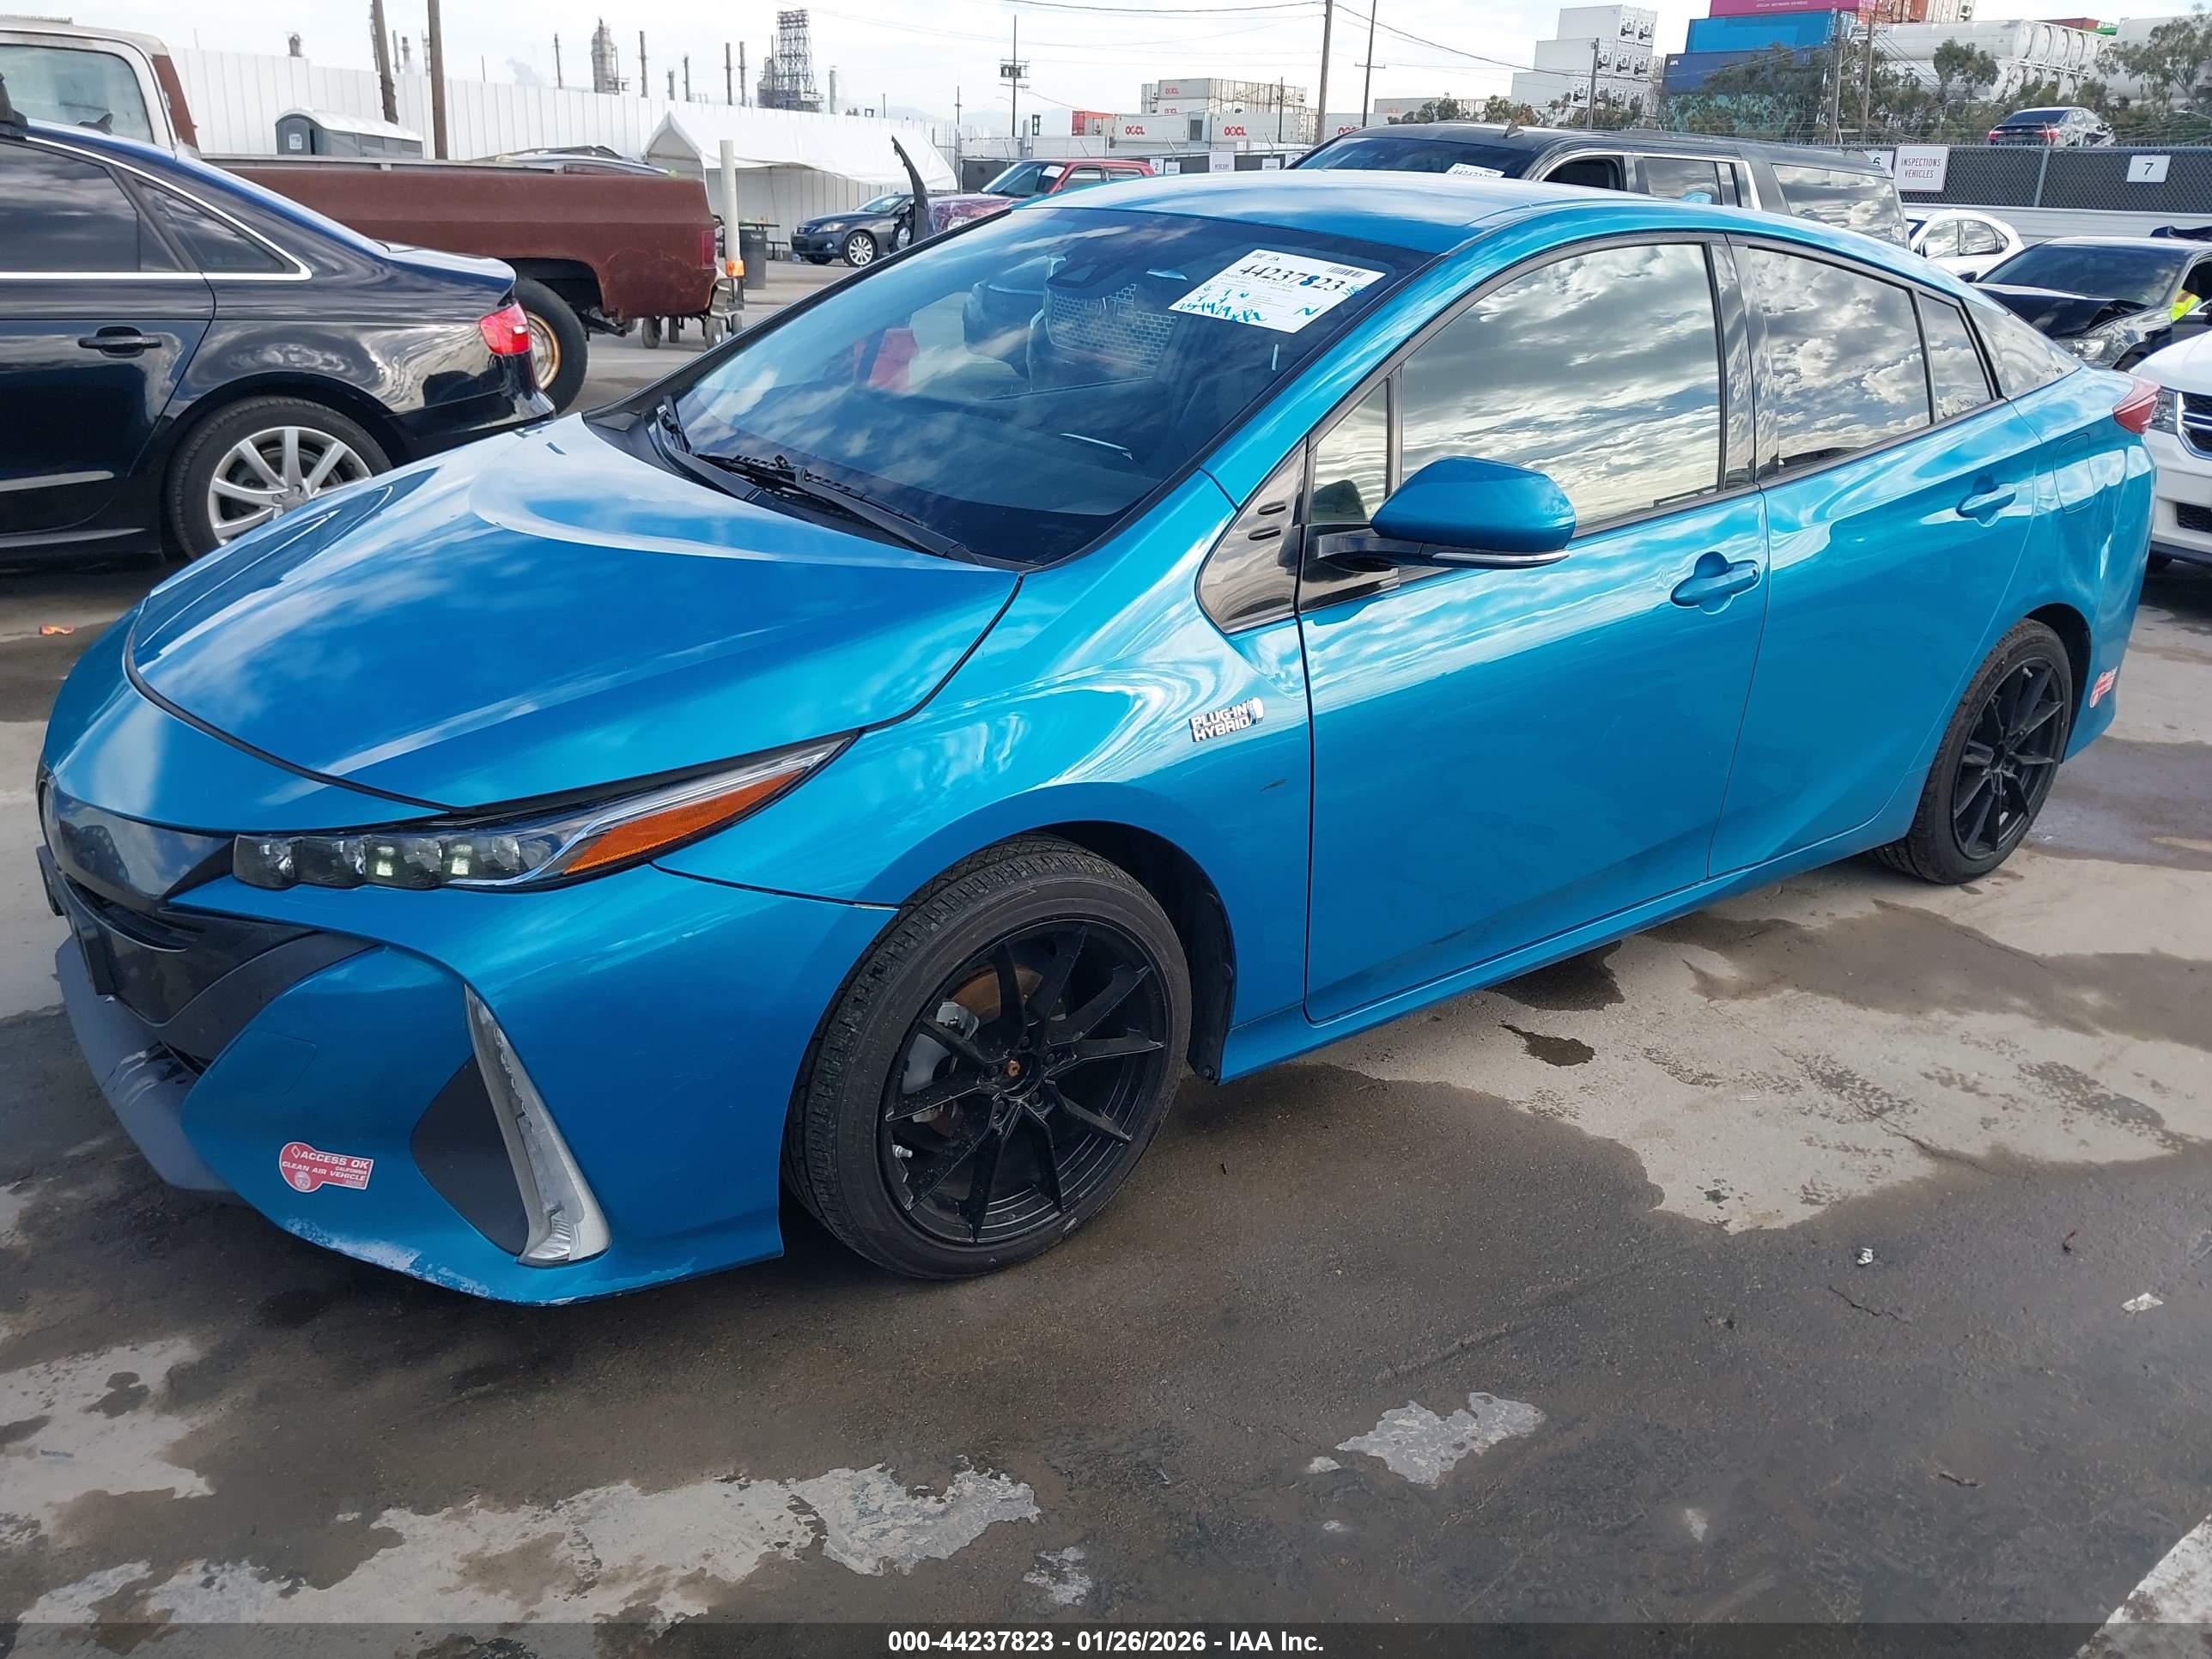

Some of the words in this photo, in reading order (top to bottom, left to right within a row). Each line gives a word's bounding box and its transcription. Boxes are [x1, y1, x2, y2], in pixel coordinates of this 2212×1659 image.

[1125, 125, 1146, 136] OOCL
[1224, 125, 1247, 137] OOCL
[1154, 162, 1159, 171] 2
[1901, 157, 1942, 167] INSPECTIONS
[1905, 169, 1935, 179] VEHICLES
[2144, 162, 2154, 176] 7
[1240, 264, 1346, 292] 44237823
[1190, 702, 1249, 729] PLUG-IN
[1192, 716, 1252, 742] HYBRID
[300, 1151, 347, 1166] ACCESS
[351, 1159, 370, 1170] OK
[282, 1161, 310, 1171] CLEAN
[330, 1170, 367, 1182] VEHICLE
[335, 1166, 368, 1175] CALIFORNIA
